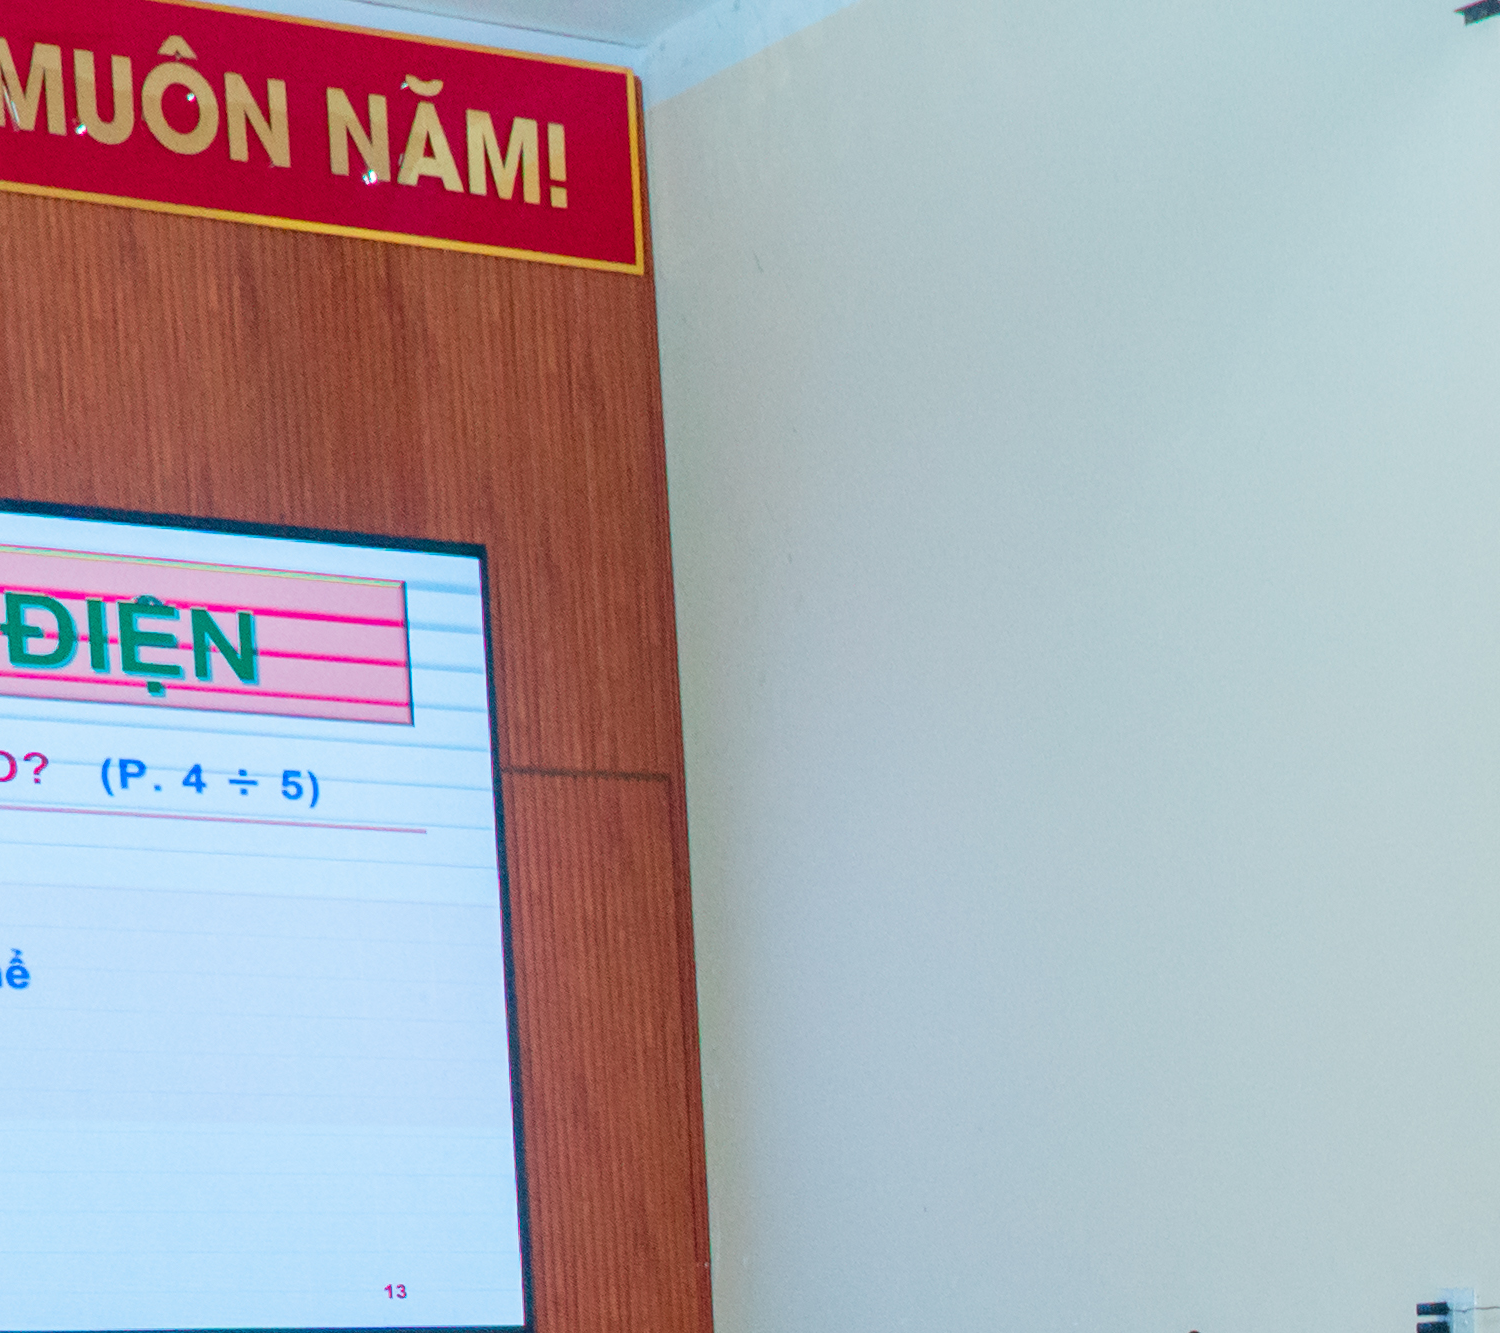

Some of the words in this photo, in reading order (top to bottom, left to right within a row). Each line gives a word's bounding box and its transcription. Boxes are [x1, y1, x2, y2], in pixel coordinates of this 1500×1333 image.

[325, 75, 569, 209] NĂM!
[0, 592, 259, 697] ĐIỆN
[101, 758, 162, 796] (P.
[182, 764, 207, 794] 4
[282, 770, 319, 808] 5)
[385, 1284, 406, 1298] 13
